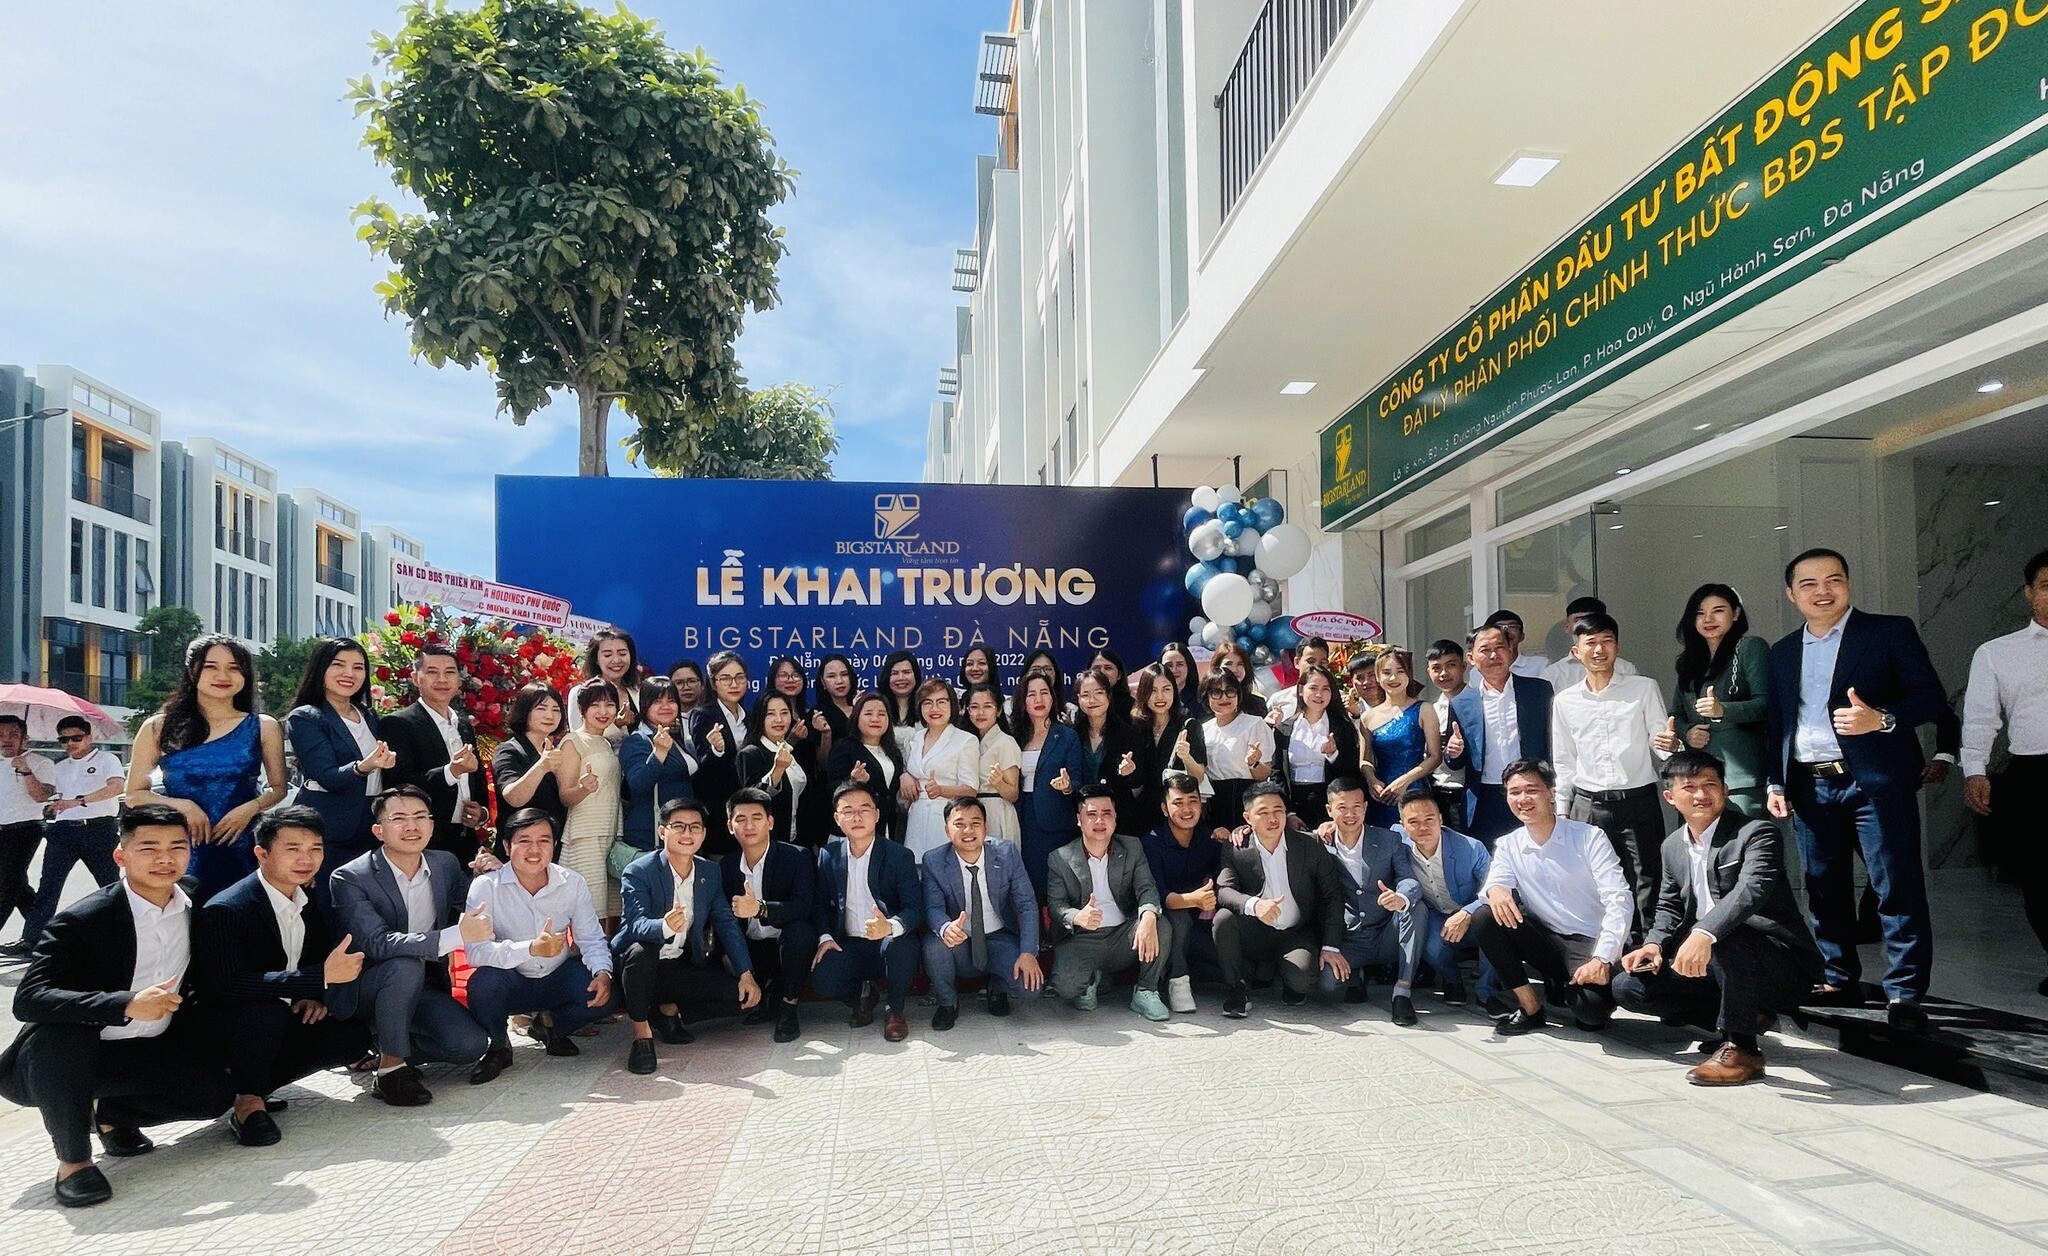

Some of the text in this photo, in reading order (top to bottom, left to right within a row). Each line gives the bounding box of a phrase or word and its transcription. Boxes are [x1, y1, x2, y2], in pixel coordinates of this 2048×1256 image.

[1379, 7, 1903, 418] CÔNG TY CỔ PHẦN ĐẦU TƯ BẤT ĐỘNG
[1403, 403, 1427, 437] ĐẠI
[1432, 384, 1449, 419] LÝ
[1453, 352, 1501, 404] PHÂN
[1508, 308, 1557, 368] PHỐI
[1565, 250, 1648, 327] CHÍNH
[1657, 181, 1750, 266] THỨC
[1763, 118, 1844, 199] BĐS
[1858, 44, 1950, 131] TẬP
[1556, 364, 1580, 385] Lan,
[1583, 353, 1592, 369] P.
[1597, 340, 1622, 361] Hòa
[1626, 317, 1657, 343] Quý,
[1661, 304, 1677, 322] Q.
[1683, 280, 1715, 308] Ngũ
[1720, 250, 1767, 288] Hành
[1773, 225, 1815, 257] Sơn,
[1823, 199, 1853, 228] Đà
[1861, 158, 1925, 205] Nẵng
[835, 541, 960, 557] BIGSTARLAND
[416, 567, 426, 580] GD
[470, 578, 484, 591] KIM
[696, 549, 1096, 606] LỄ KHAI TRƯƠNG
[490, 589, 525, 605] HOLDINGS
[512, 608, 530, 618] KHAI
[685, 617, 1110, 649] BIGSTARLAND ĐÀ NẴNG
[793, 651, 821, 668] Nẵn
[938, 654, 954, 667] 06
[995, 653, 1025, 666] 2022
